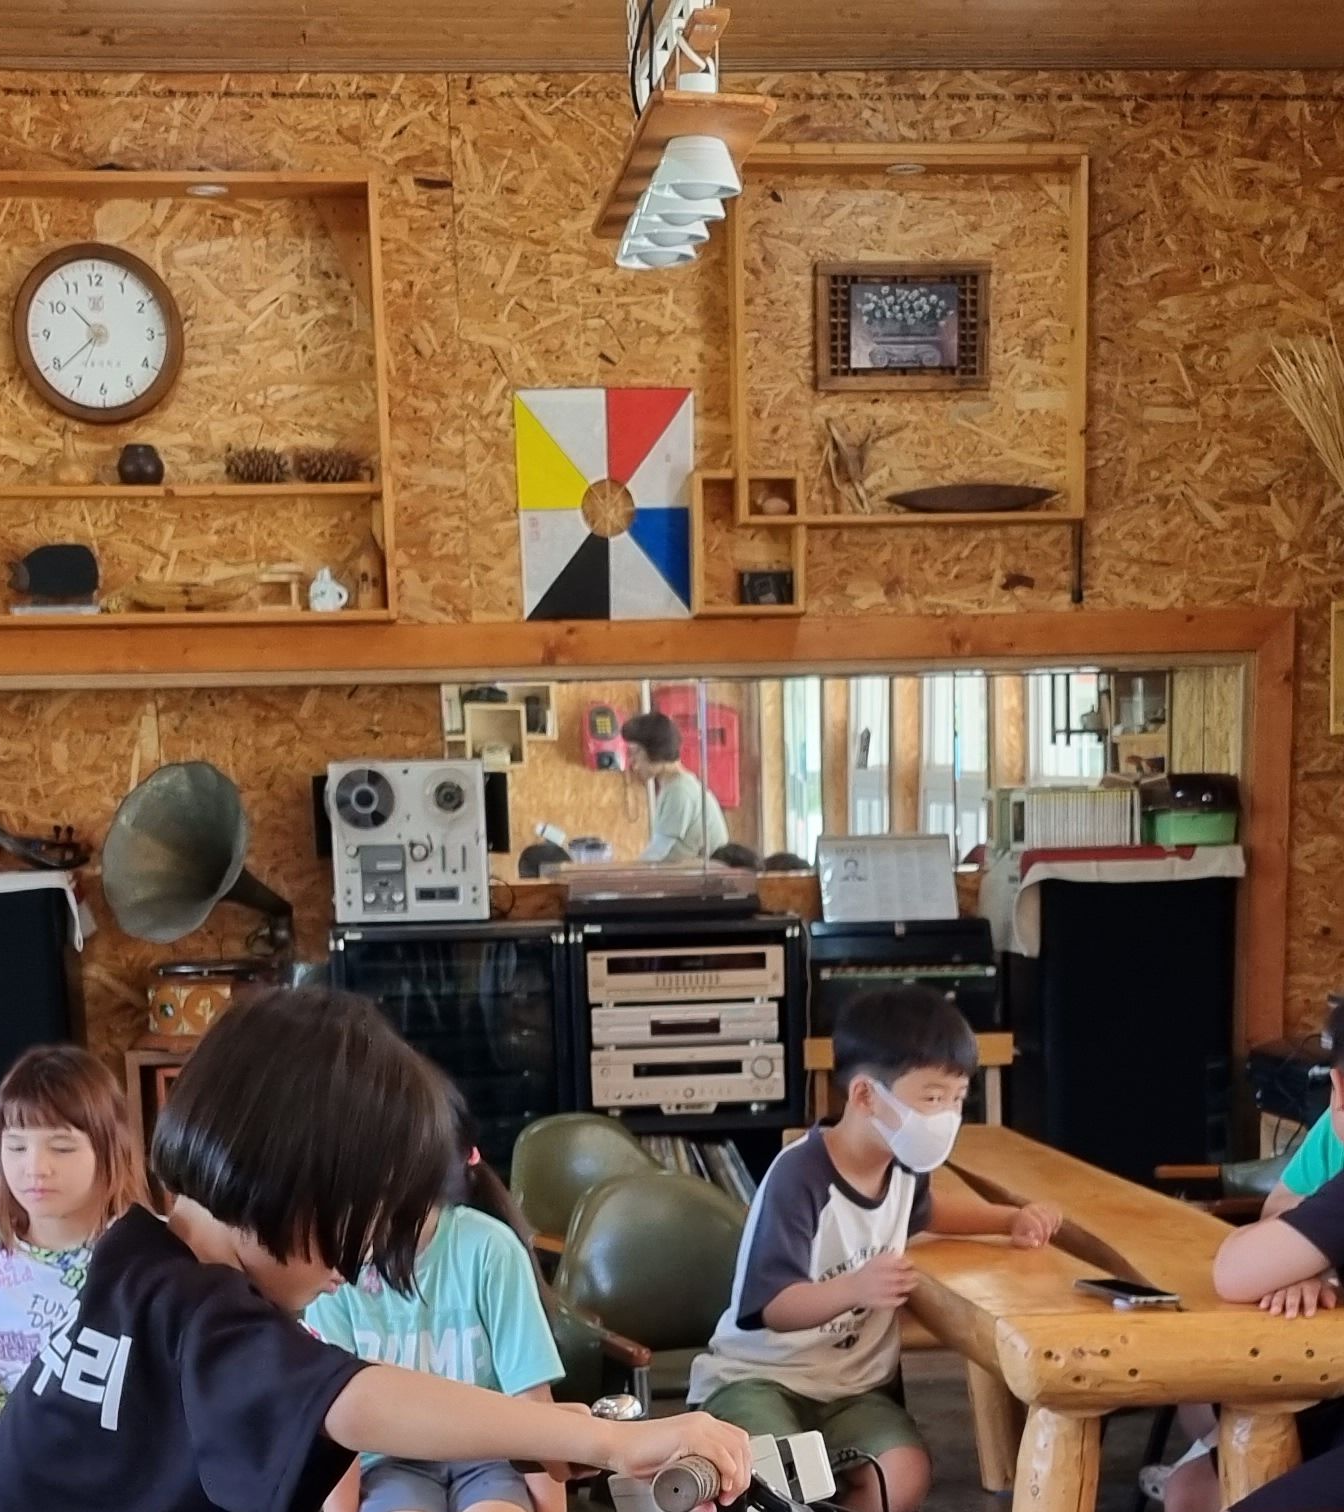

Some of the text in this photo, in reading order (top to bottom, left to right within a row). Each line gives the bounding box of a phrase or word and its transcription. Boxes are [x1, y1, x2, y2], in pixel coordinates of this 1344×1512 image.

[87, 274, 103, 287] 12
[65, 282, 79, 295] 11
[119, 282, 125, 294] 1
[49, 301, 66, 314] 10
[136, 301, 145, 313] 2
[42, 328, 51, 341] 9
[146, 328, 155, 341] 3
[52, 357, 61, 371] 8
[141, 357, 149, 369] 4
[74, 376, 83, 388] 7
[125, 375, 133, 388] 5
[99, 383, 107, 395] 6
[32, 1294, 68, 1319] FUN
